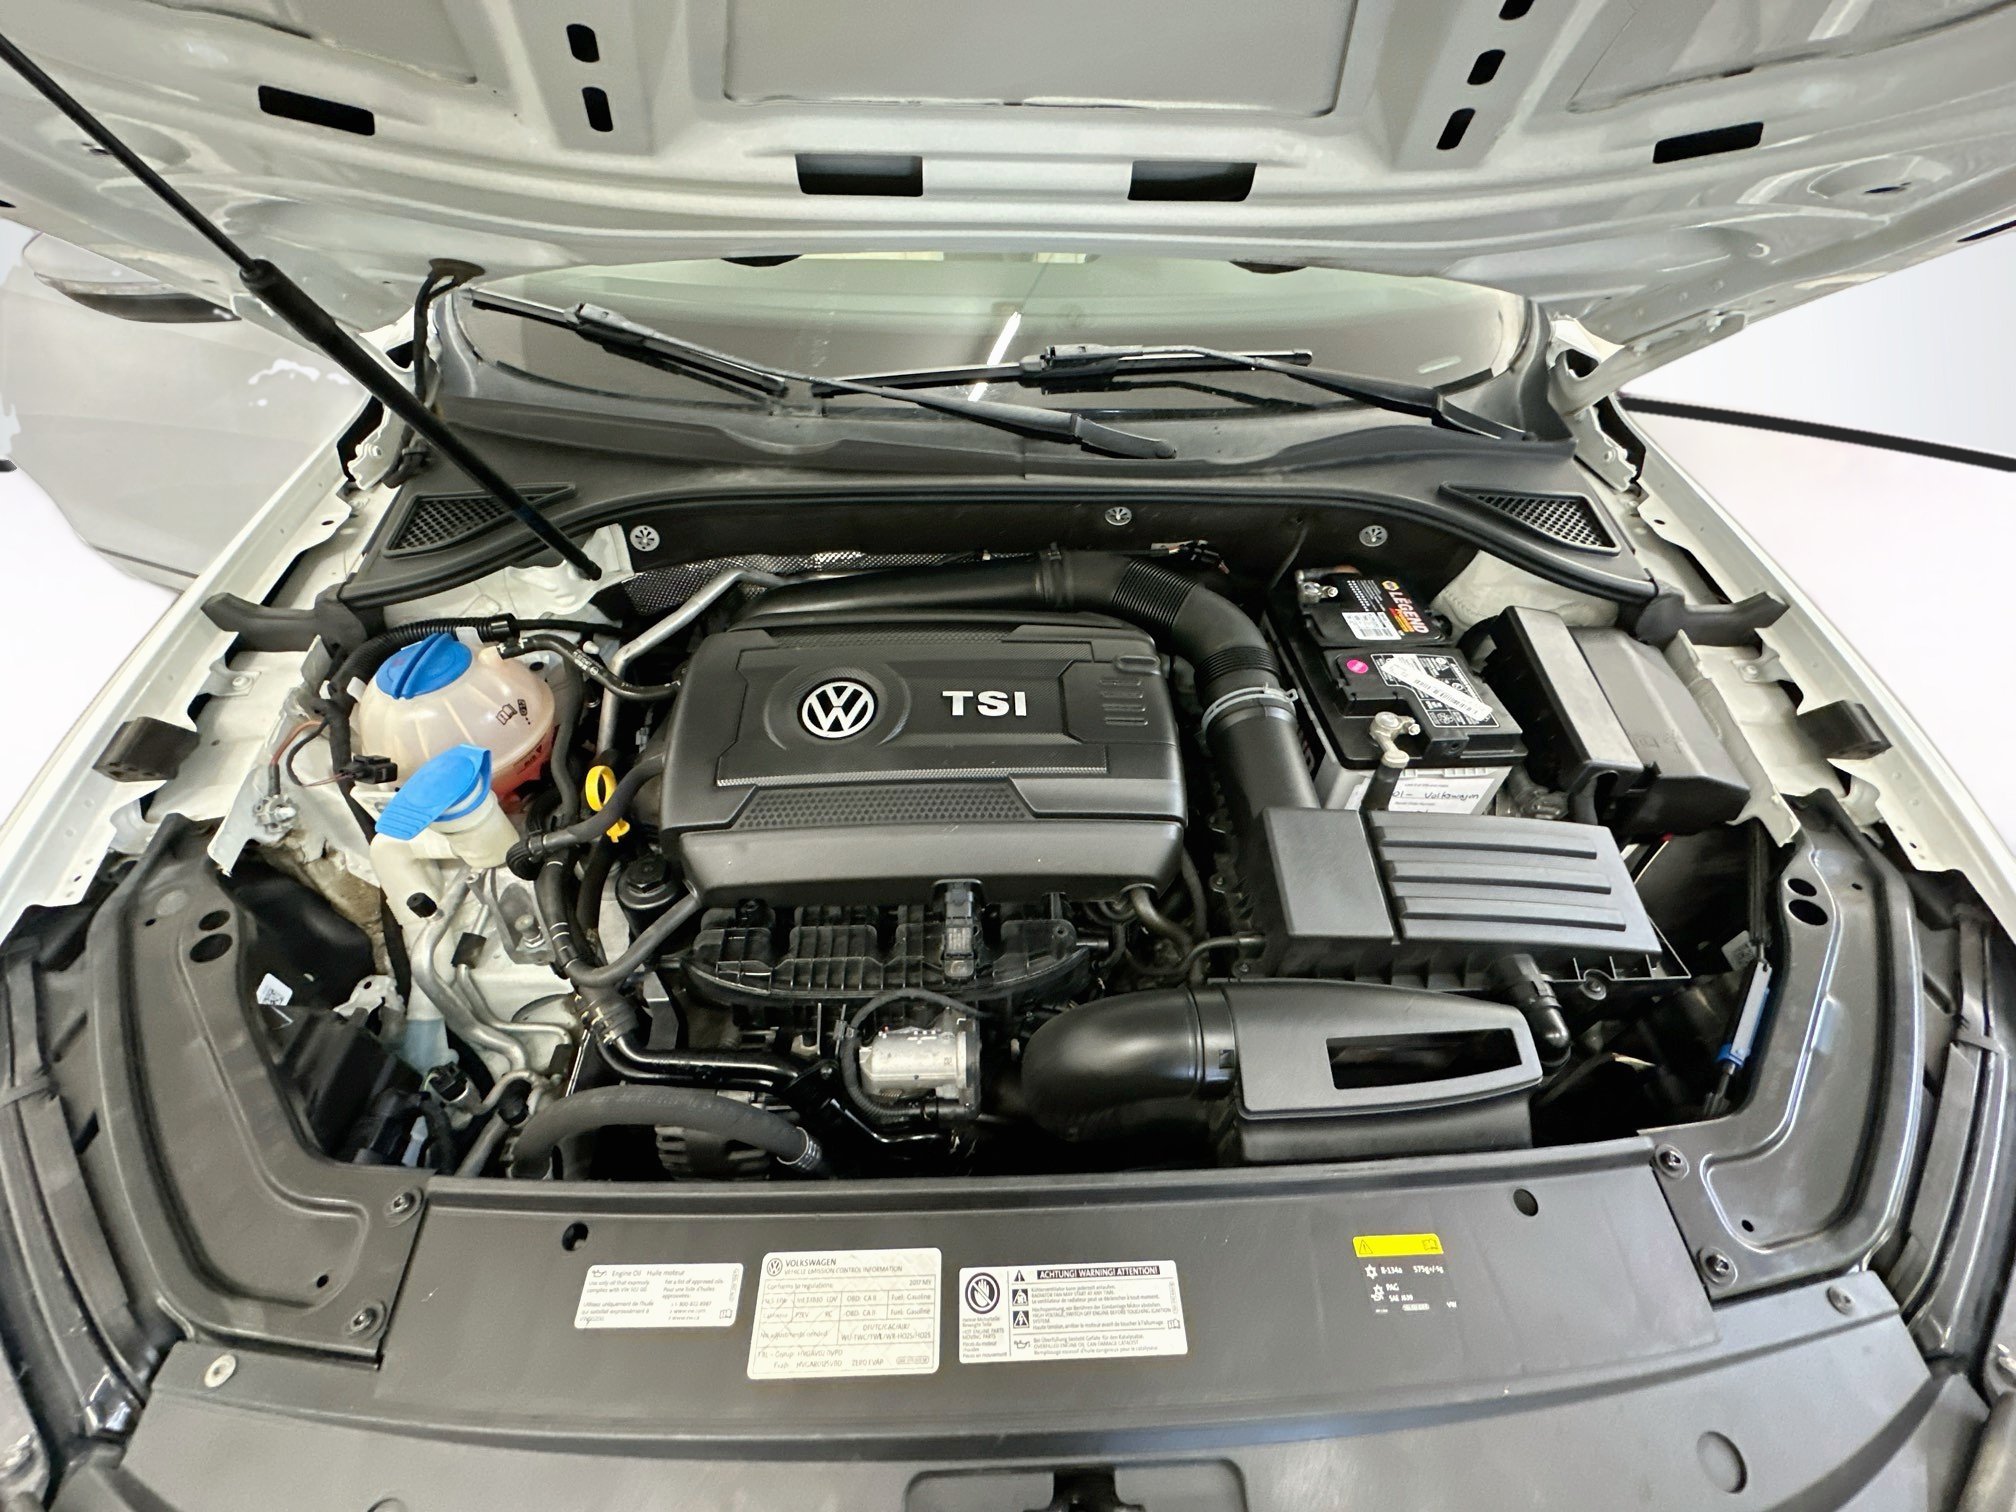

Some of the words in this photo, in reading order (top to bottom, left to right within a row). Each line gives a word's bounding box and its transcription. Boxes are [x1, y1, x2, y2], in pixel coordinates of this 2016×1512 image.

[942, 690, 1027, 716] TSI
[785, 1258, 837, 1267] VOLKSWAGEN
[612, 1270, 632, 1278] Engine
[1039, 1270, 1077, 1279] ACHTUNG!
[1079, 1269, 1116, 1278] WARNING!
[1117, 1267, 1158, 1276] ATTENTION!
